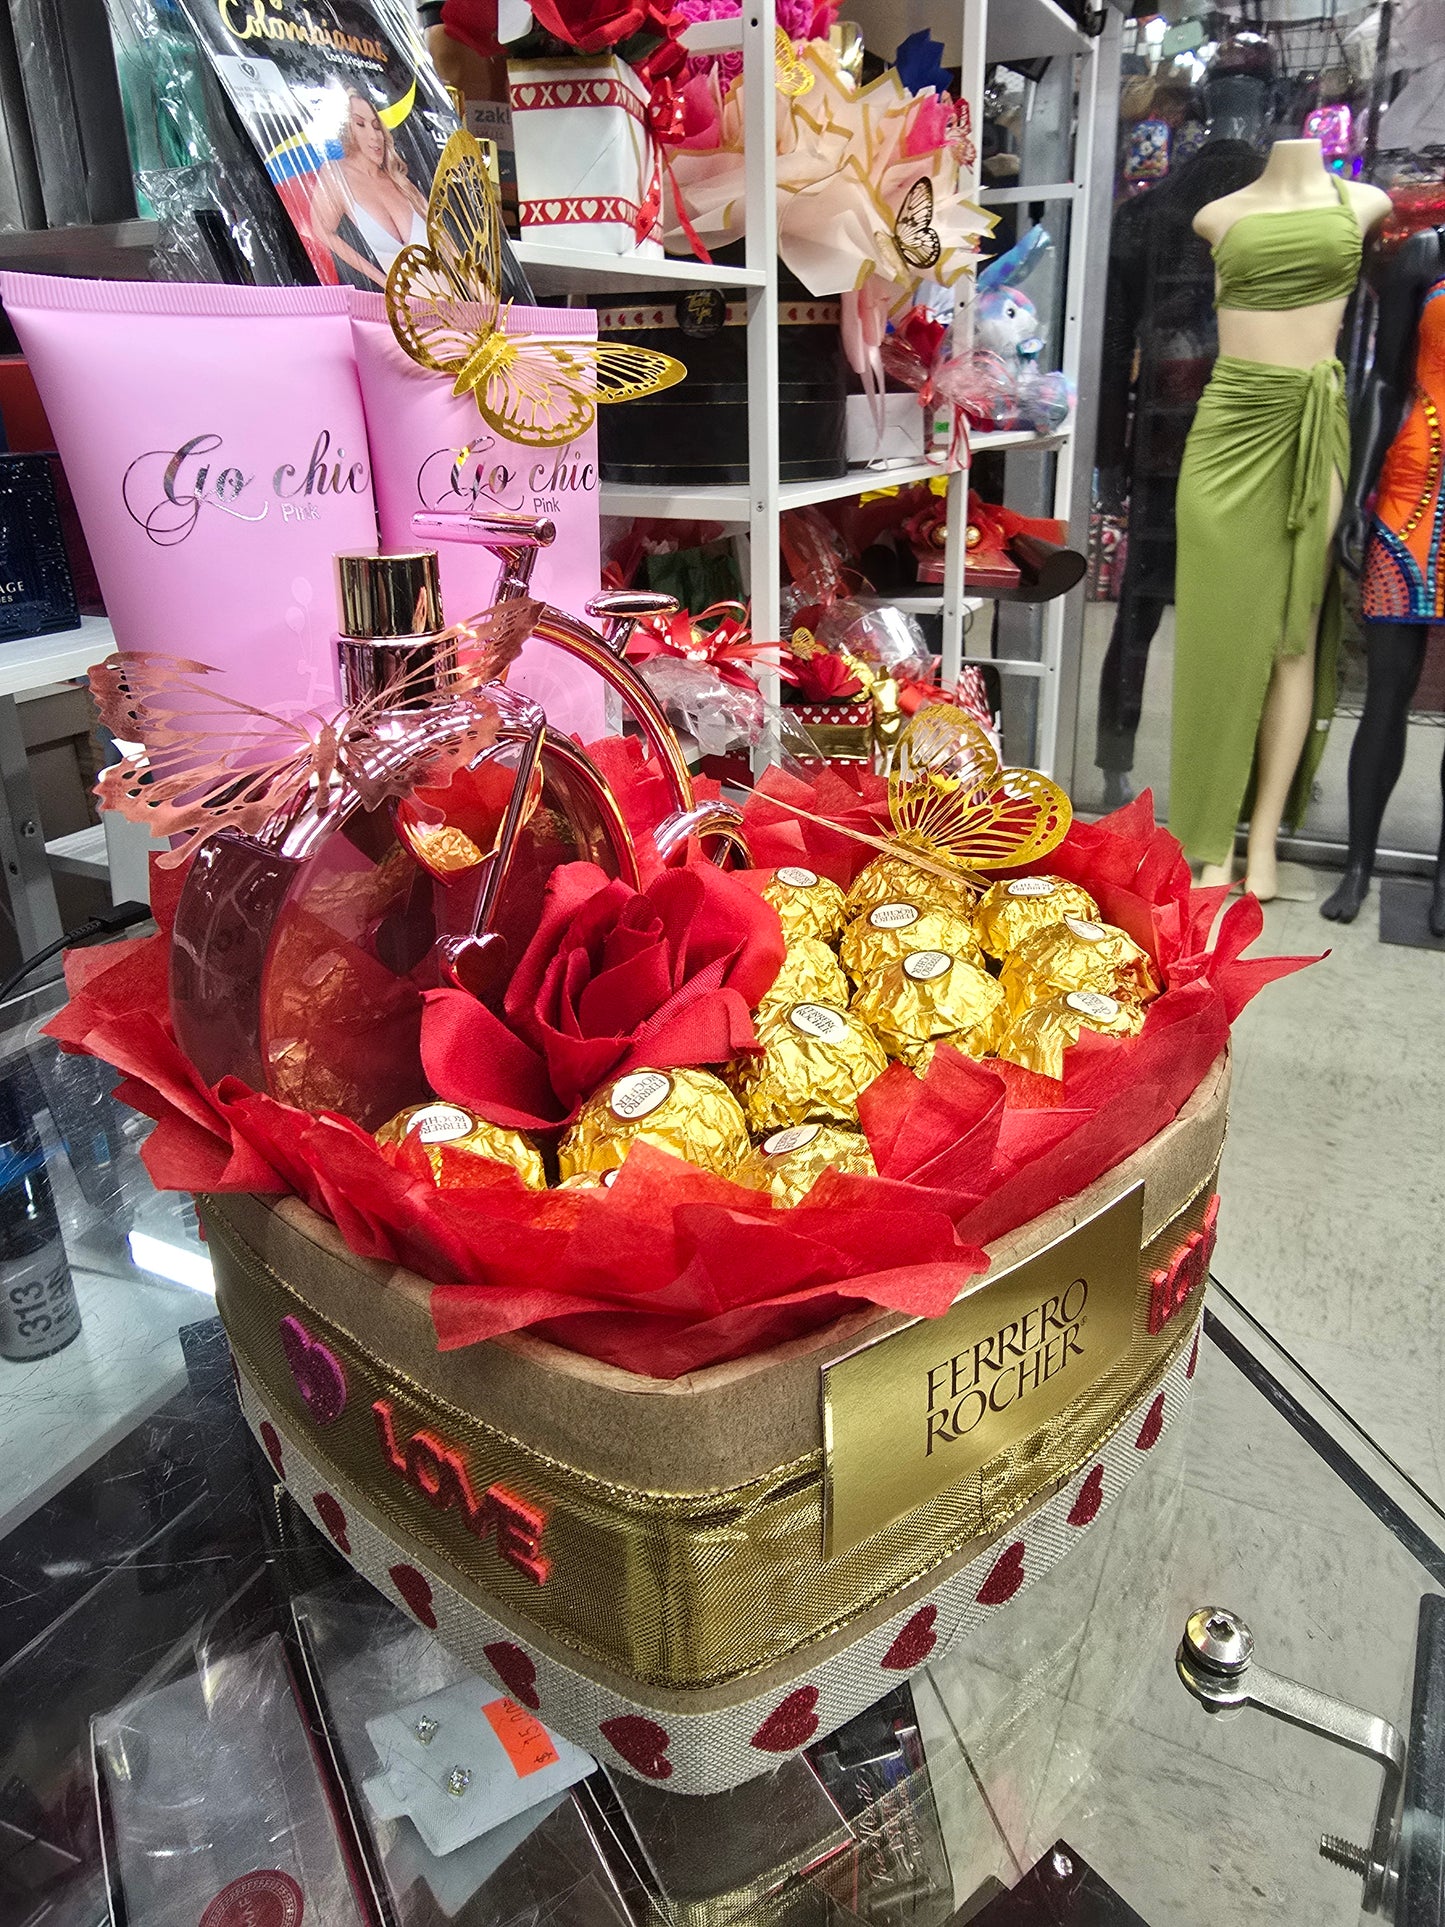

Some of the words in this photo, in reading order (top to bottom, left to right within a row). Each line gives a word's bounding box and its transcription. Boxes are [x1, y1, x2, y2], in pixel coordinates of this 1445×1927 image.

[218, 0, 388, 62] Colombianas
[122, 433, 268, 546] Go
[272, 429, 370, 499] chic
[417, 436, 524, 511] Go
[528, 445, 599, 493] chic
[533, 497, 561, 513] Pink
[281, 502, 321, 523] Pink
[615, 1074, 659, 1109] ROCHER
[623, 1078, 666, 1115] FERRERO
[926, 1278, 1089, 1413] FERRERO
[925, 1323, 1085, 1457] ROCHER
[371, 1400, 552, 1587] LOVE
